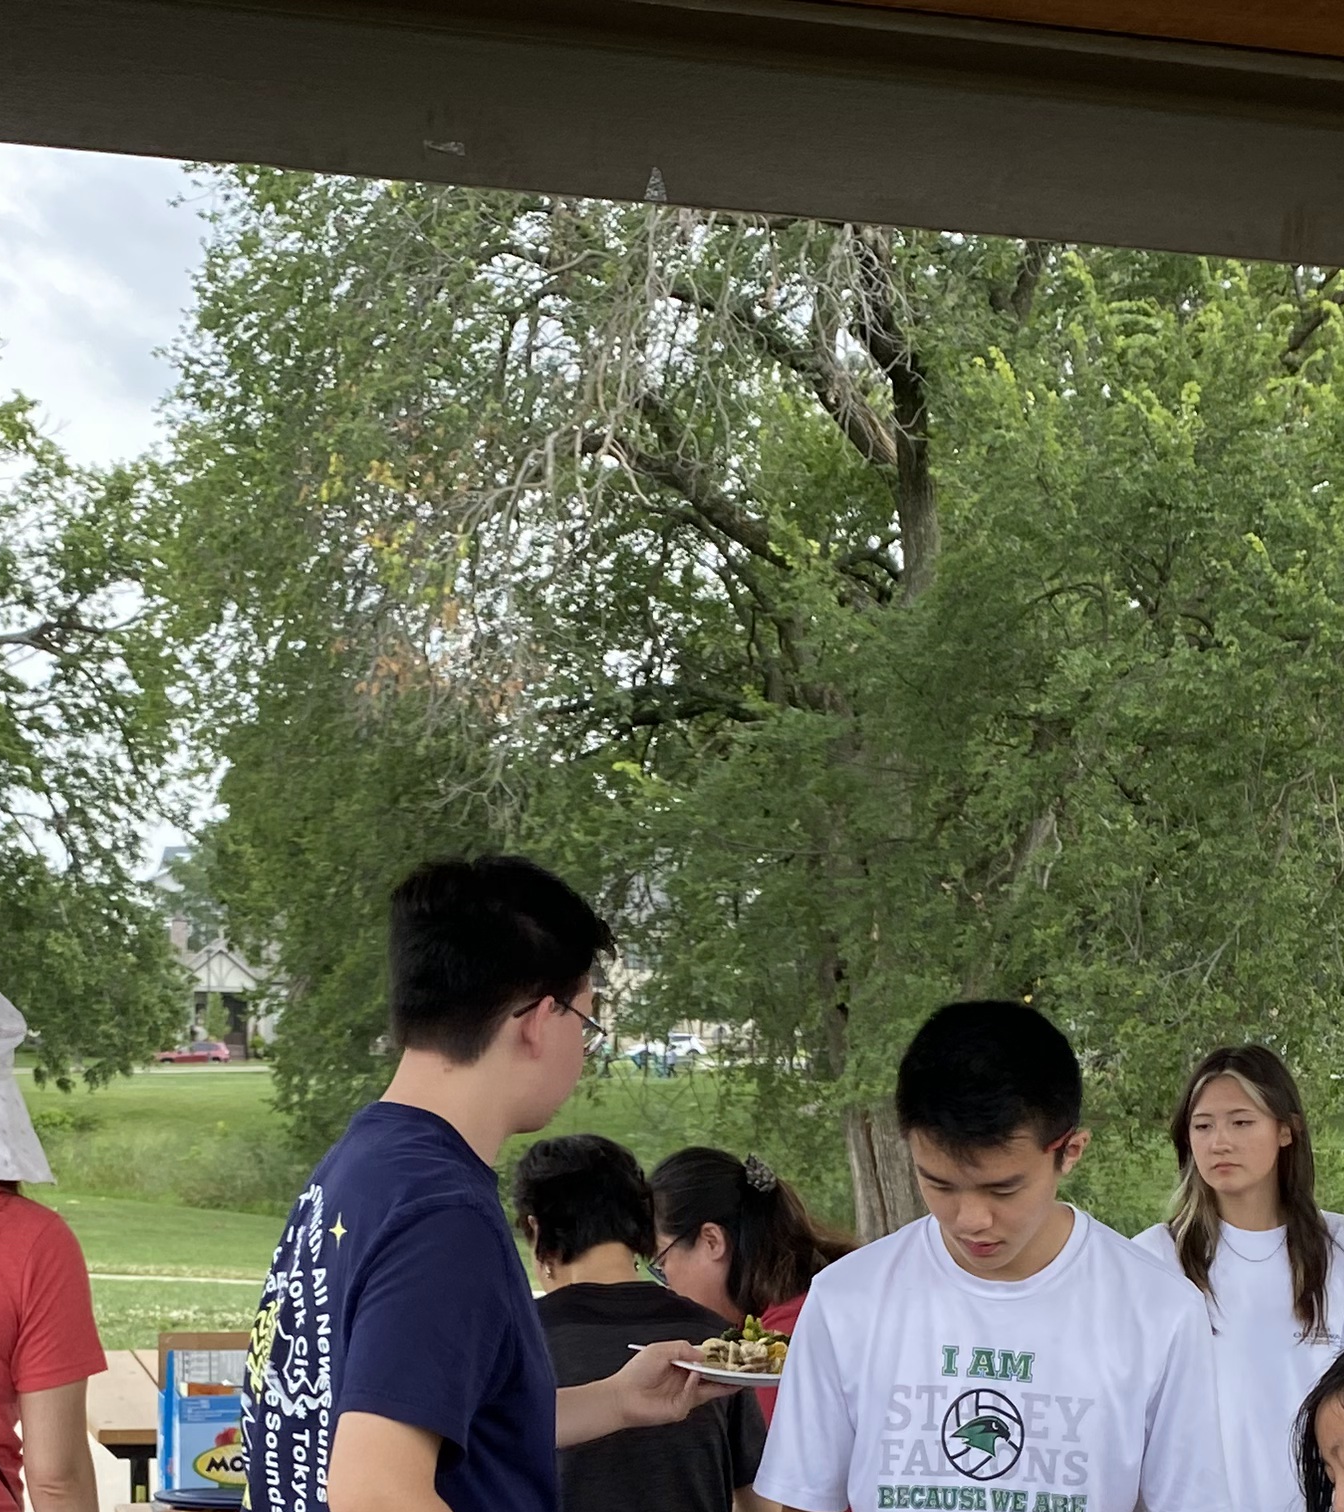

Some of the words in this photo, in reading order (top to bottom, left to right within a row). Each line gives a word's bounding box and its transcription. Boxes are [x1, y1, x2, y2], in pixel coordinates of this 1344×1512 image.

[312, 1268, 329, 1306] All
[293, 1335, 310, 1381] Cit
[941, 1344, 960, 1377] I
[966, 1346, 1036, 1382] AM
[205, 1455, 245, 1472] MO
[316, 1391, 332, 1504] Sounds
[877, 1484, 987, 1512] BECAUSE
